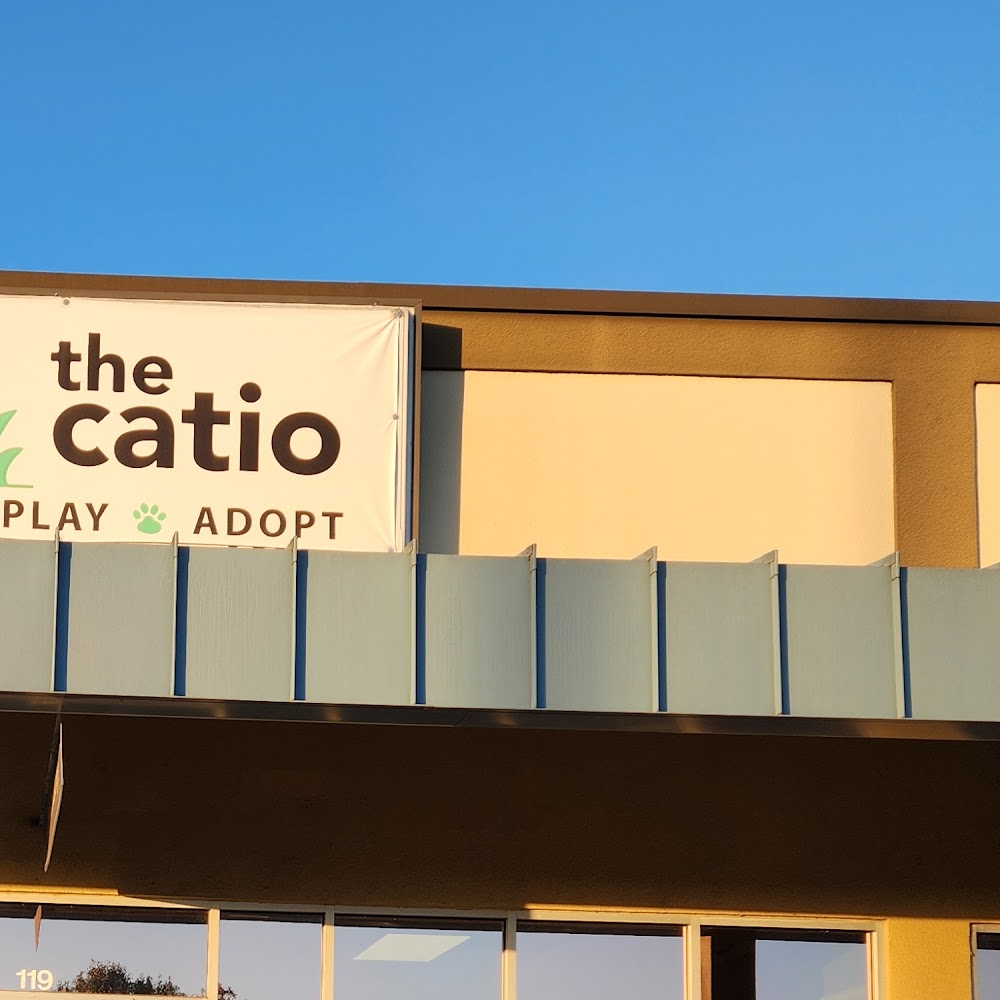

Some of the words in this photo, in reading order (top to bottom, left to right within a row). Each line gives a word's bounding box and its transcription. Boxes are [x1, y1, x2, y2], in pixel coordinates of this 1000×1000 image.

[51, 332, 174, 396] the
[53, 382, 341, 476] catio
[3, 499, 109, 531] PLAY
[193, 507, 343, 540] ADOPT
[15, 969, 54, 991] 119
